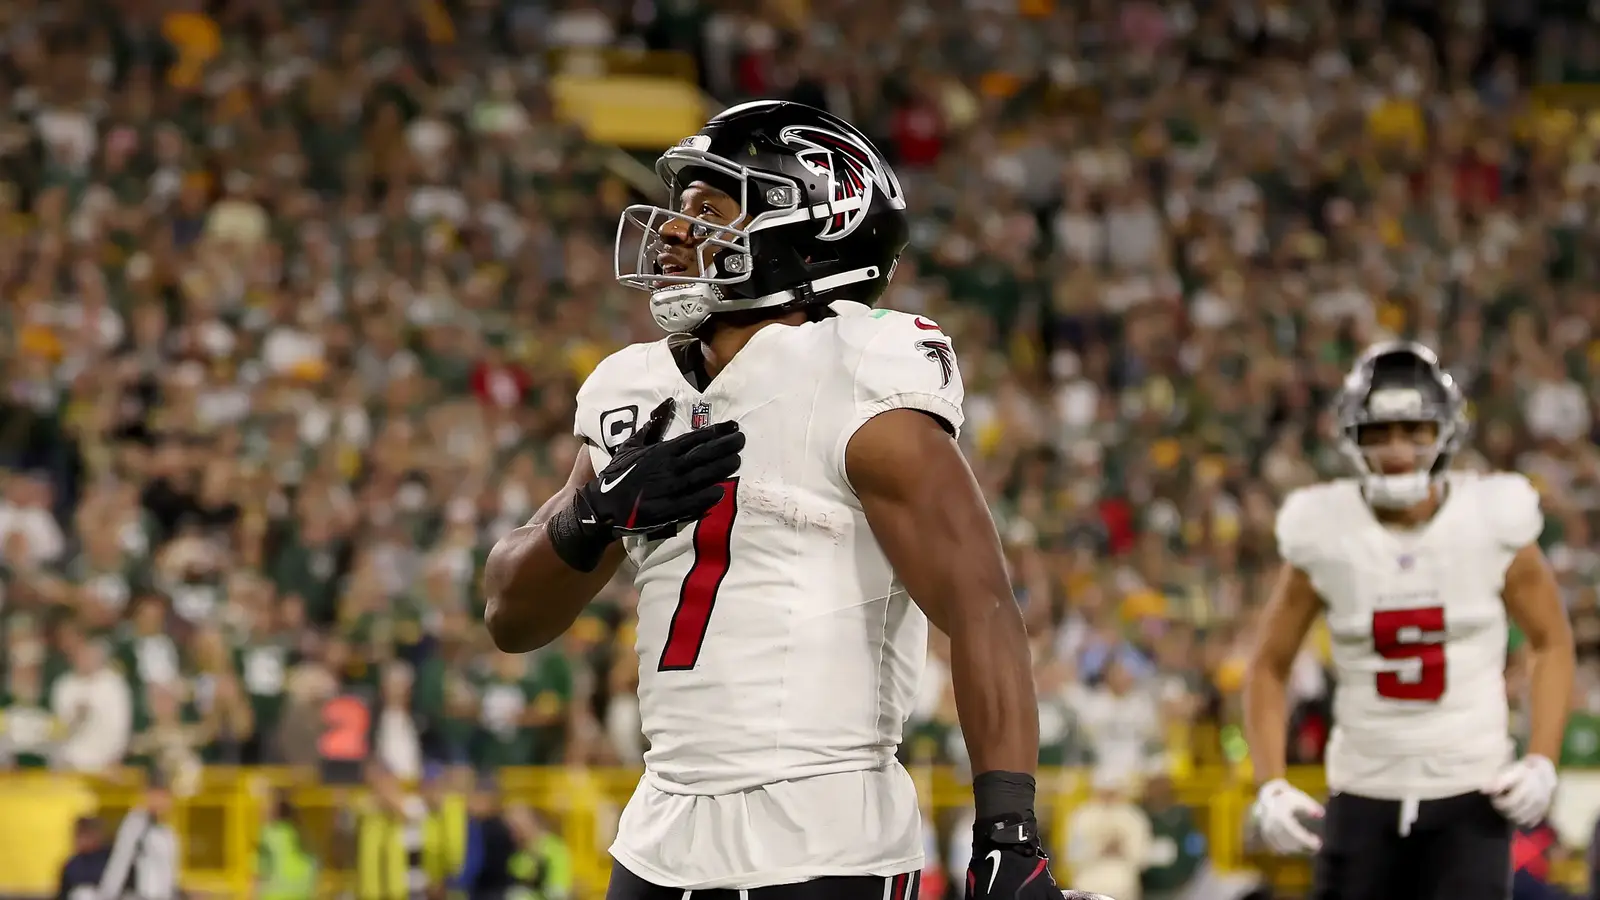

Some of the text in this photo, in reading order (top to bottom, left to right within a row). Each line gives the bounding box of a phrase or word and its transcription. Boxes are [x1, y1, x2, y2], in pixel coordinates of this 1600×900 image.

[601, 407, 636, 449] C
[647, 476, 740, 672] 7
[1372, 606, 1446, 702] 5
